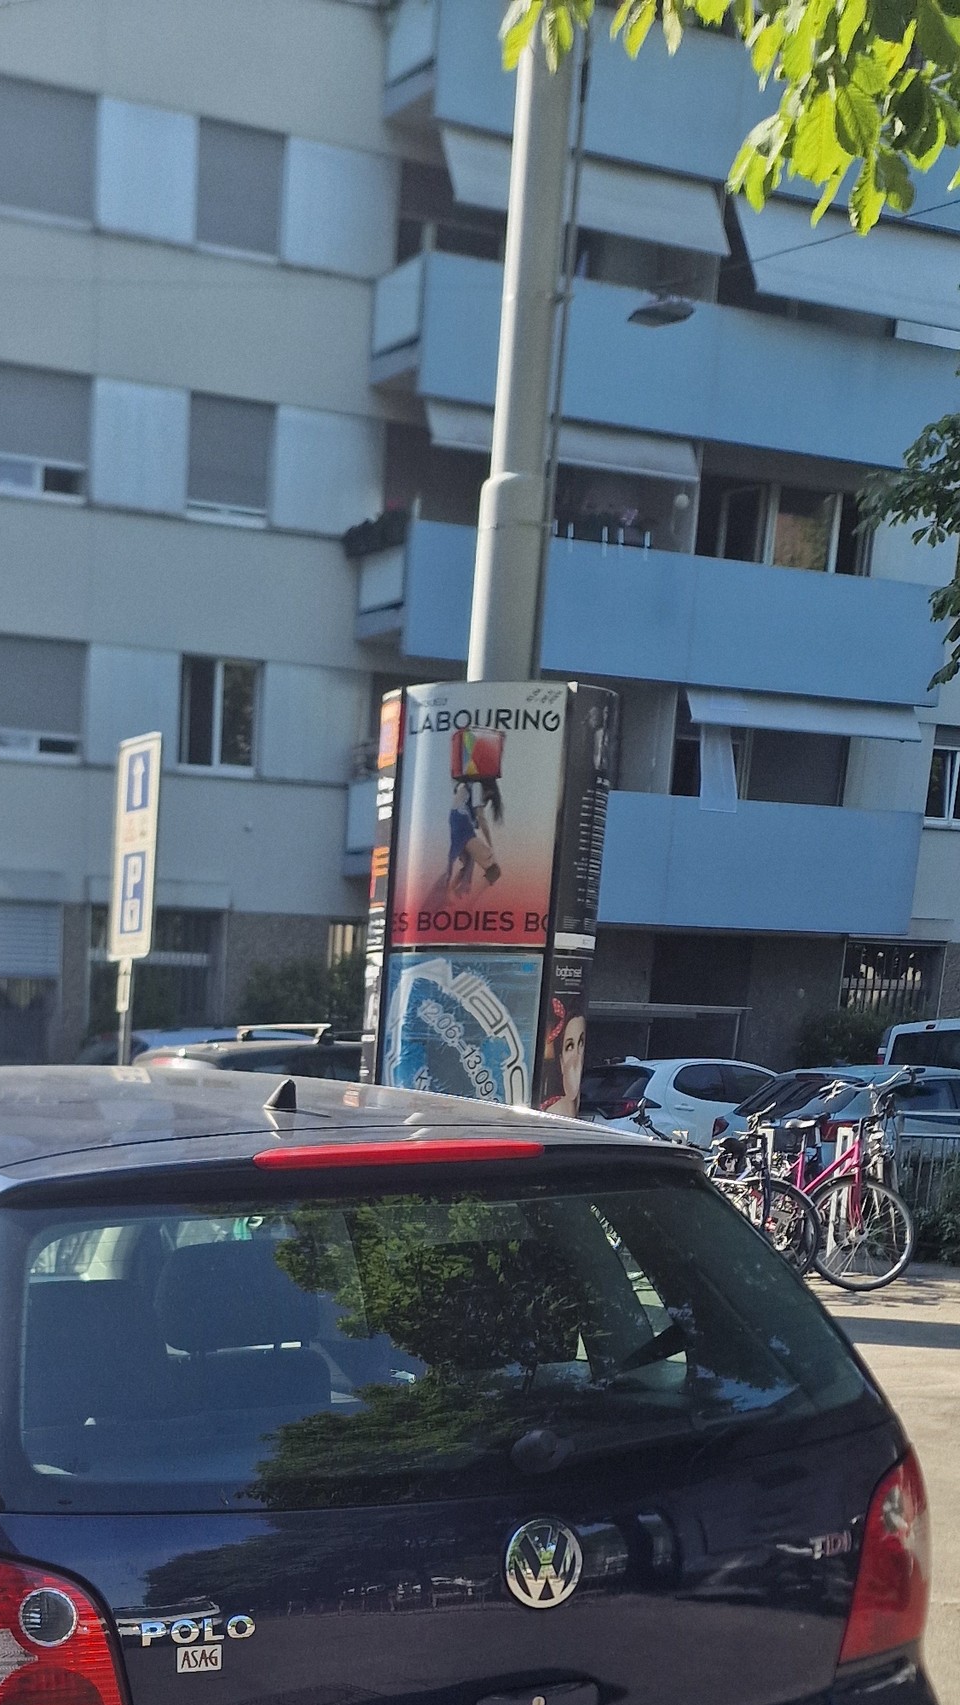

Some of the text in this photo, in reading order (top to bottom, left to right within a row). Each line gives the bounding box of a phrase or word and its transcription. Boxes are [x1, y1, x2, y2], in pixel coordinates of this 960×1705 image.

[408, 708, 560, 735] LABOURING
[127, 855, 143, 898] P
[417, 911, 515, 932] BODIES
[141, 1614, 256, 1647] POLO
[181, 1649, 218, 1669] ASAG
